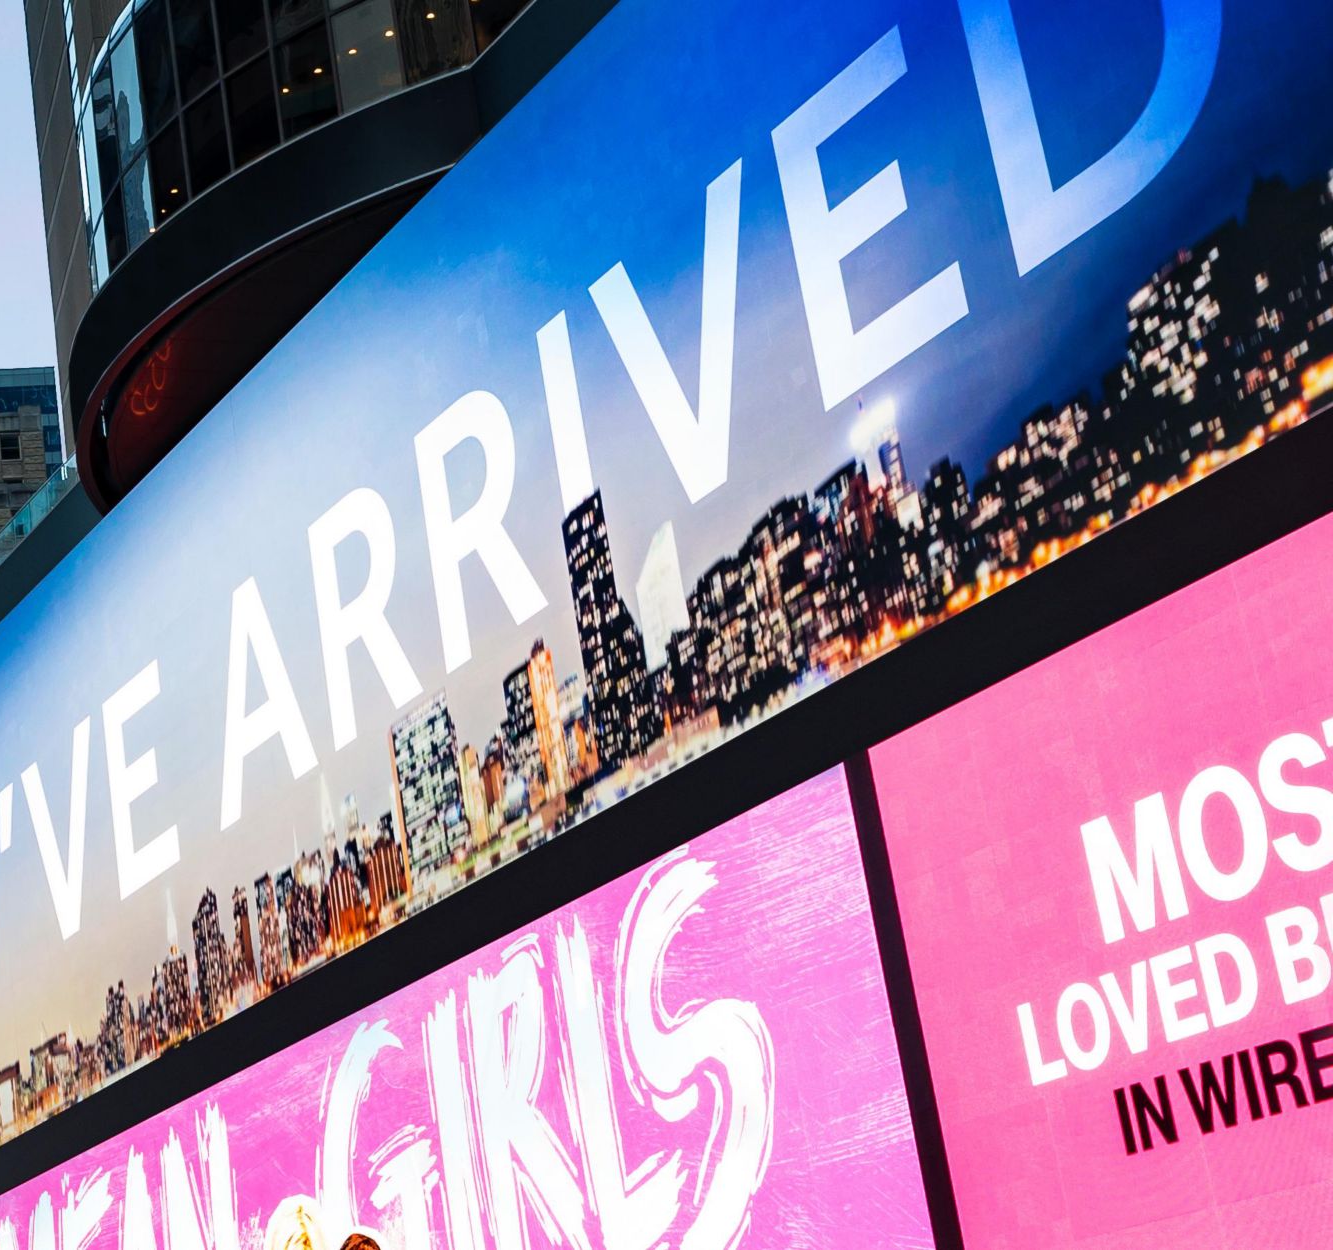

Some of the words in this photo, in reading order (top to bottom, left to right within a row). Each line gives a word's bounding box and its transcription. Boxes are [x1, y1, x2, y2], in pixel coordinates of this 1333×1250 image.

[218, 0, 1224, 829] ARRIVED
[1080, 719, 1333, 945] MOS
[315, 844, 775, 1250] GIRLS
[1016, 930, 1259, 1086] LOVED
[1113, 1081, 1179, 1156] IN
